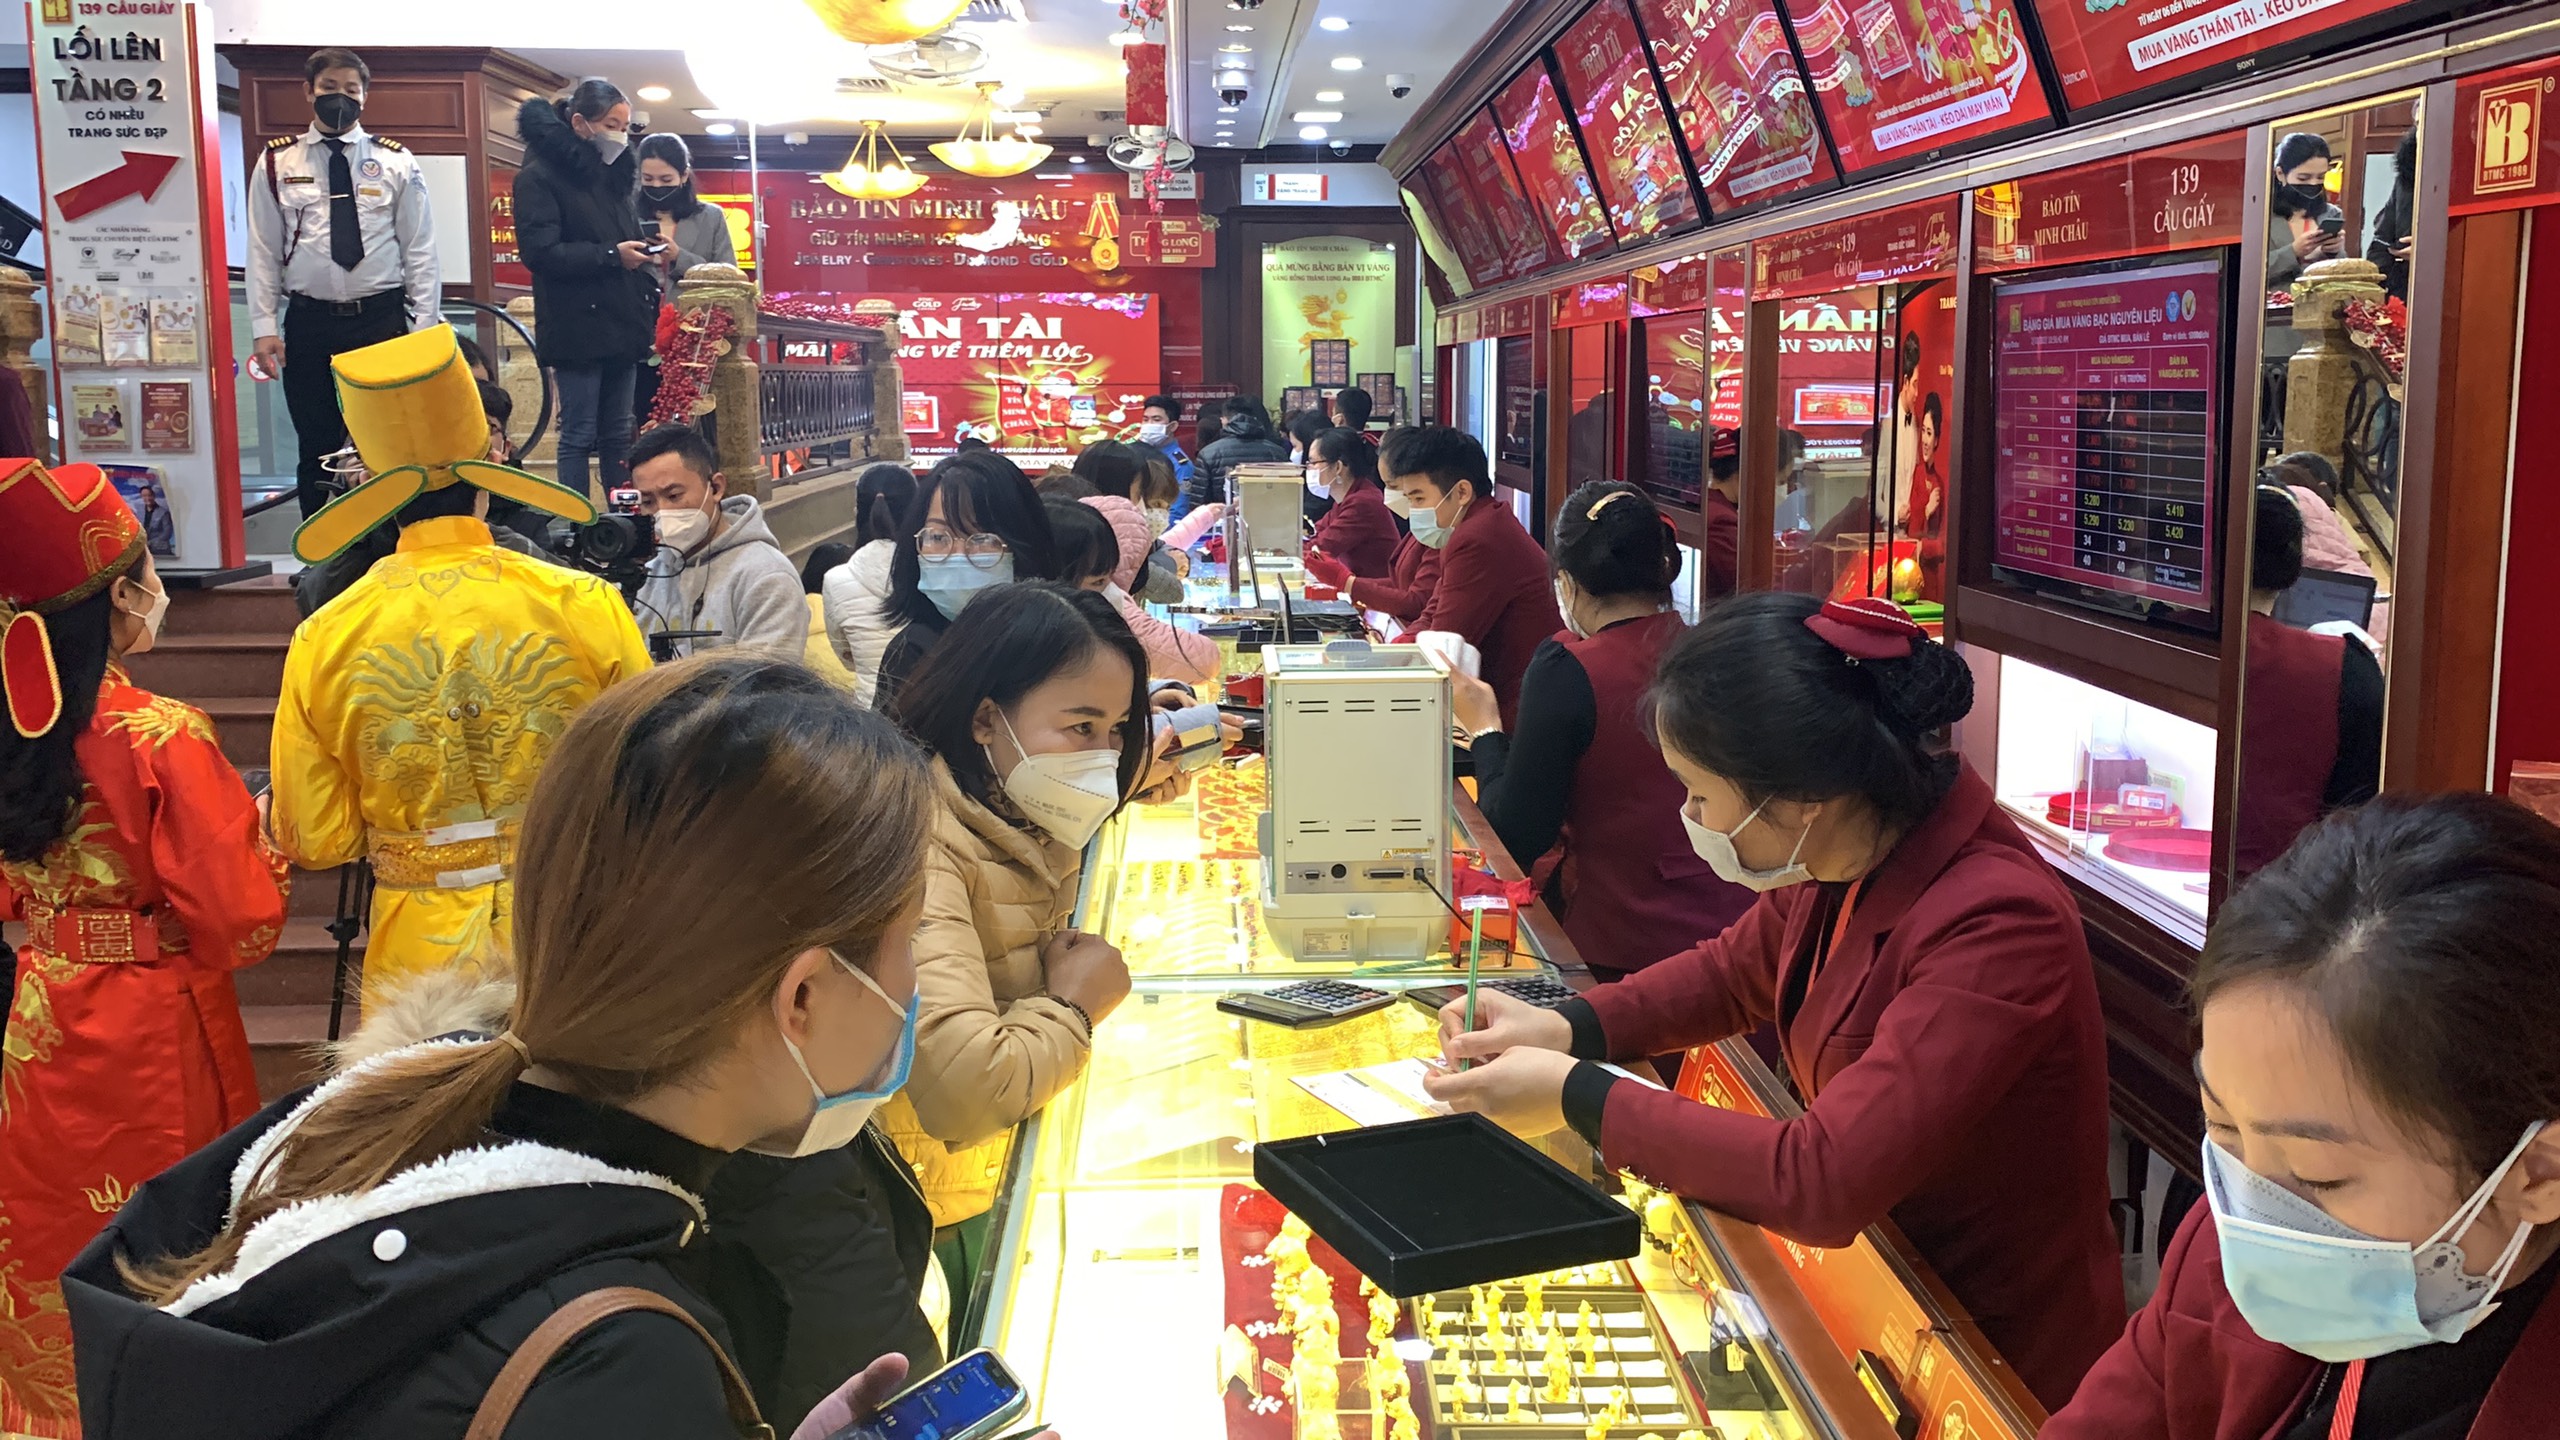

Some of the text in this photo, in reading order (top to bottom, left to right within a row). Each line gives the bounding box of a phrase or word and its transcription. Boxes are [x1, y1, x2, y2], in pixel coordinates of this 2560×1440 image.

[78, 3, 102, 14] 139
[53, 25, 161, 60] LỐI LÊN
[2138, 42, 2166, 64] MUA
[2164, 28, 2199, 54] VÀNG
[2198, 14, 2235, 42] THẦN
[2234, 8, 2257, 29] TÀI
[2236, 58, 2256, 70] SONY
[52, 67, 164, 101] TẦNG 2
[86, 108, 106, 120] CÓ
[68, 128, 112, 138] TRANG
[116, 125, 140, 138] SỨC
[1877, 132, 1892, 146] MUA
[1968, 105, 1984, 119] MAY
[2170, 164, 2200, 196] 139
[2483, 164, 2528, 182] BTMC 1989
[790, 193, 984, 220] BẢO MINH
[2042, 190, 2081, 218] BẢO TÍN
[2154, 192, 2216, 234] CẦU GIẤY
[844, 229, 869, 246] TÍN
[2034, 218, 2089, 246] MINH CHÂU
[1171, 236, 1198, 247] LONG
[1030, 252, 1068, 266] GOLD
[897, 310, 1063, 339] ẦN TÀI
[2042, 314, 2054, 330] GIÁ
[2055, 316, 2071, 329] MUA
[2072, 312, 2092, 328] VÀNG
[2110, 307, 2142, 325] NGUYÊN
[896, 341, 1086, 362] NG VỀ THÊM LỘC
[2166, 504, 2184, 518] 5.410
[2083, 535, 2092, 546] 34
[2165, 525, 2184, 539] 5.420
[2117, 540, 2126, 552] 30
[2165, 548, 2170, 560] 0
[2083, 555, 2091, 566] 40
[2117, 561, 2125, 573] 40
